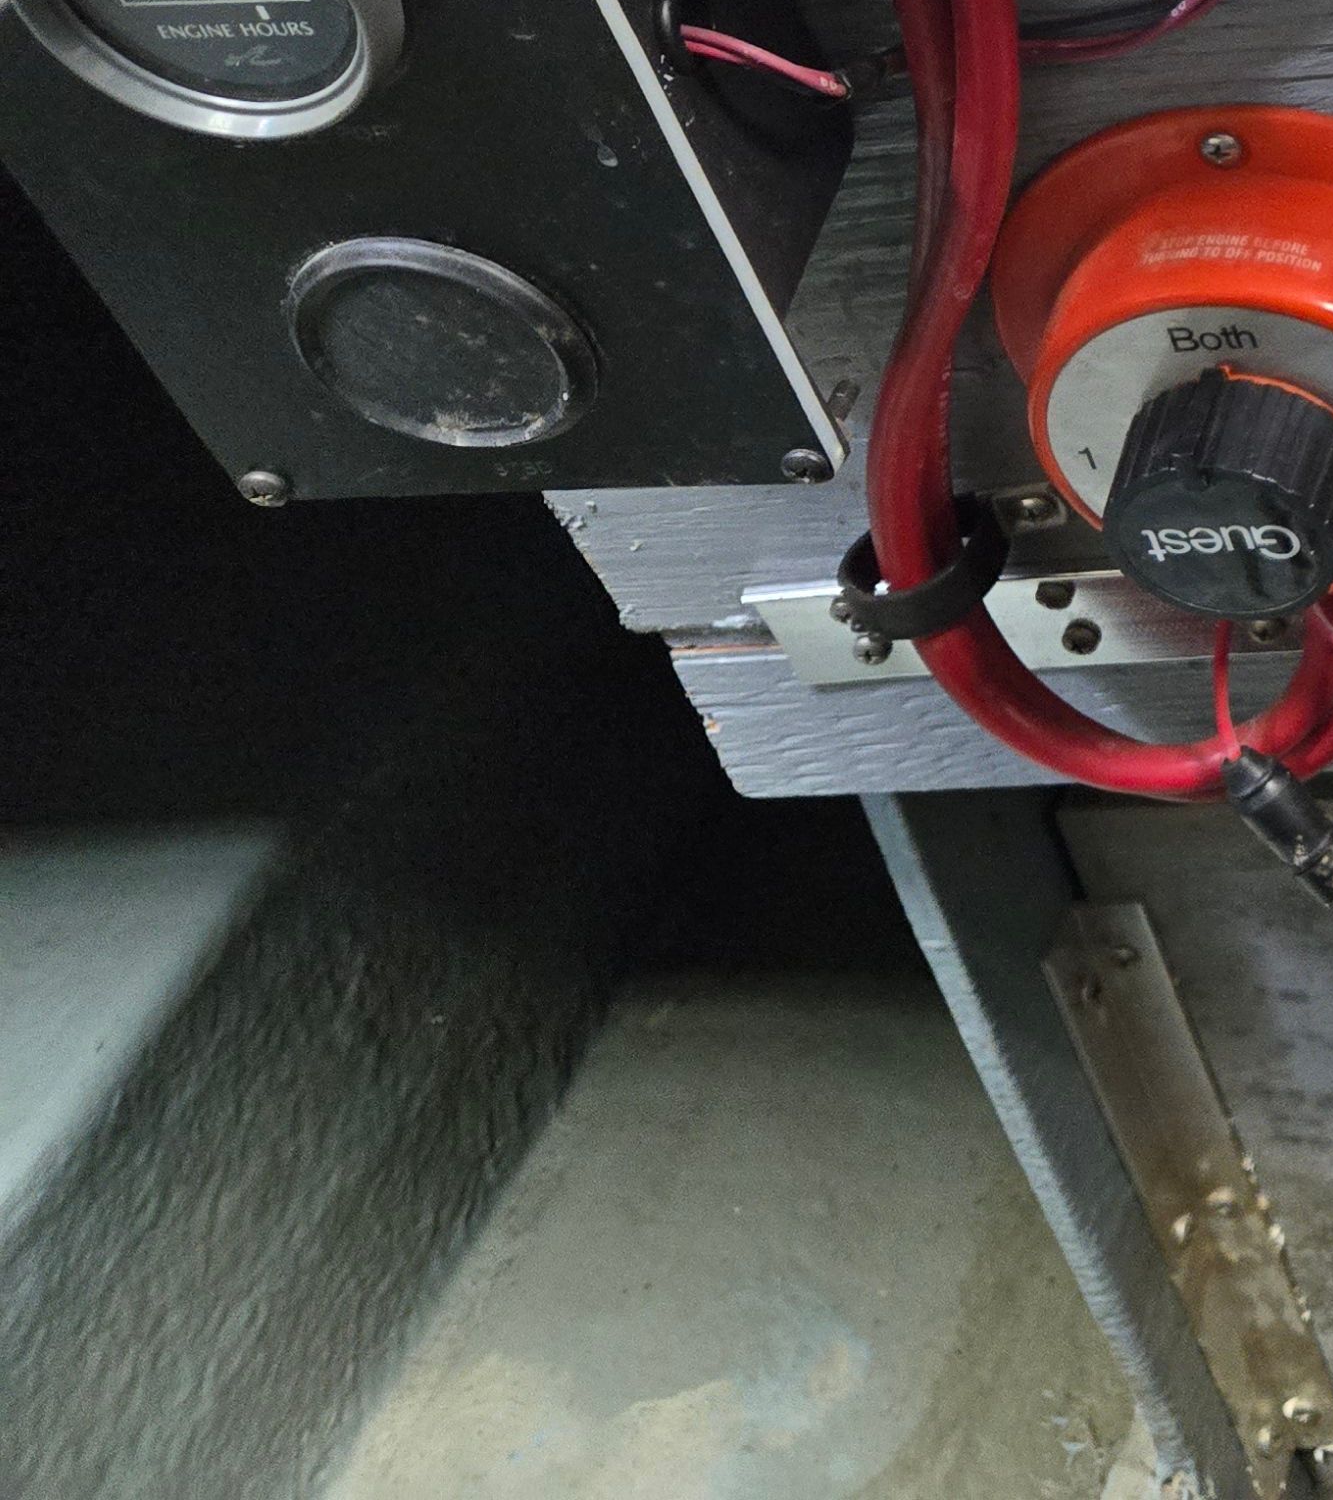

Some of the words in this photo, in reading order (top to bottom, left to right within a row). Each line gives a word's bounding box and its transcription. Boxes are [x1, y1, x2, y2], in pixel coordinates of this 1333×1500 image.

[157, 23, 234, 39] ENGINE
[240, 21, 314, 38] HOURS
[1196, 234, 1249, 246] ENGINE
[1203, 247, 1221, 258] TO
[1257, 251, 1322, 271] POSITION
[1167, 325, 1259, 353] Both
[1078, 447, 1097, 471] 1
[1141, 525, 1301, 562] Guest
